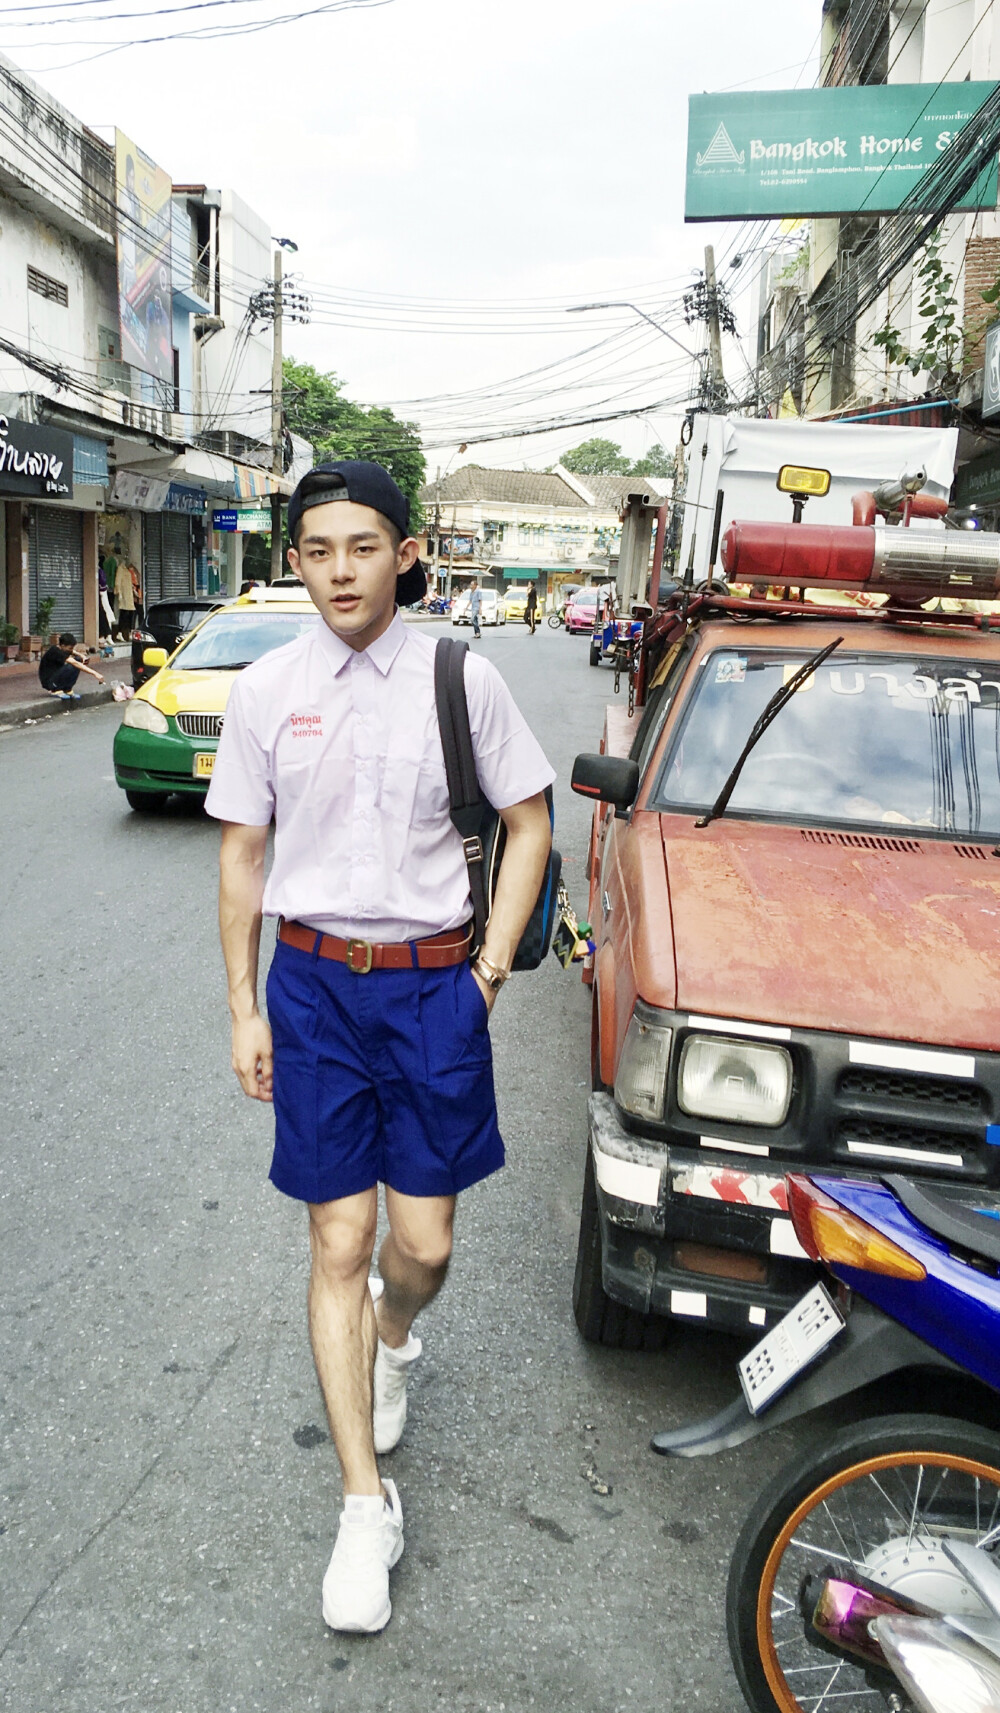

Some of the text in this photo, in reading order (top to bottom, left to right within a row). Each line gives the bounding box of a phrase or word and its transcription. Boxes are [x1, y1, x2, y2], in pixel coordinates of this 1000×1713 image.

[750, 136, 848, 161] Bangkok
[860, 135, 923, 155] Home
[893, 163, 923, 171] Thailand
[290, 712, 322, 728] นิชคุณ
